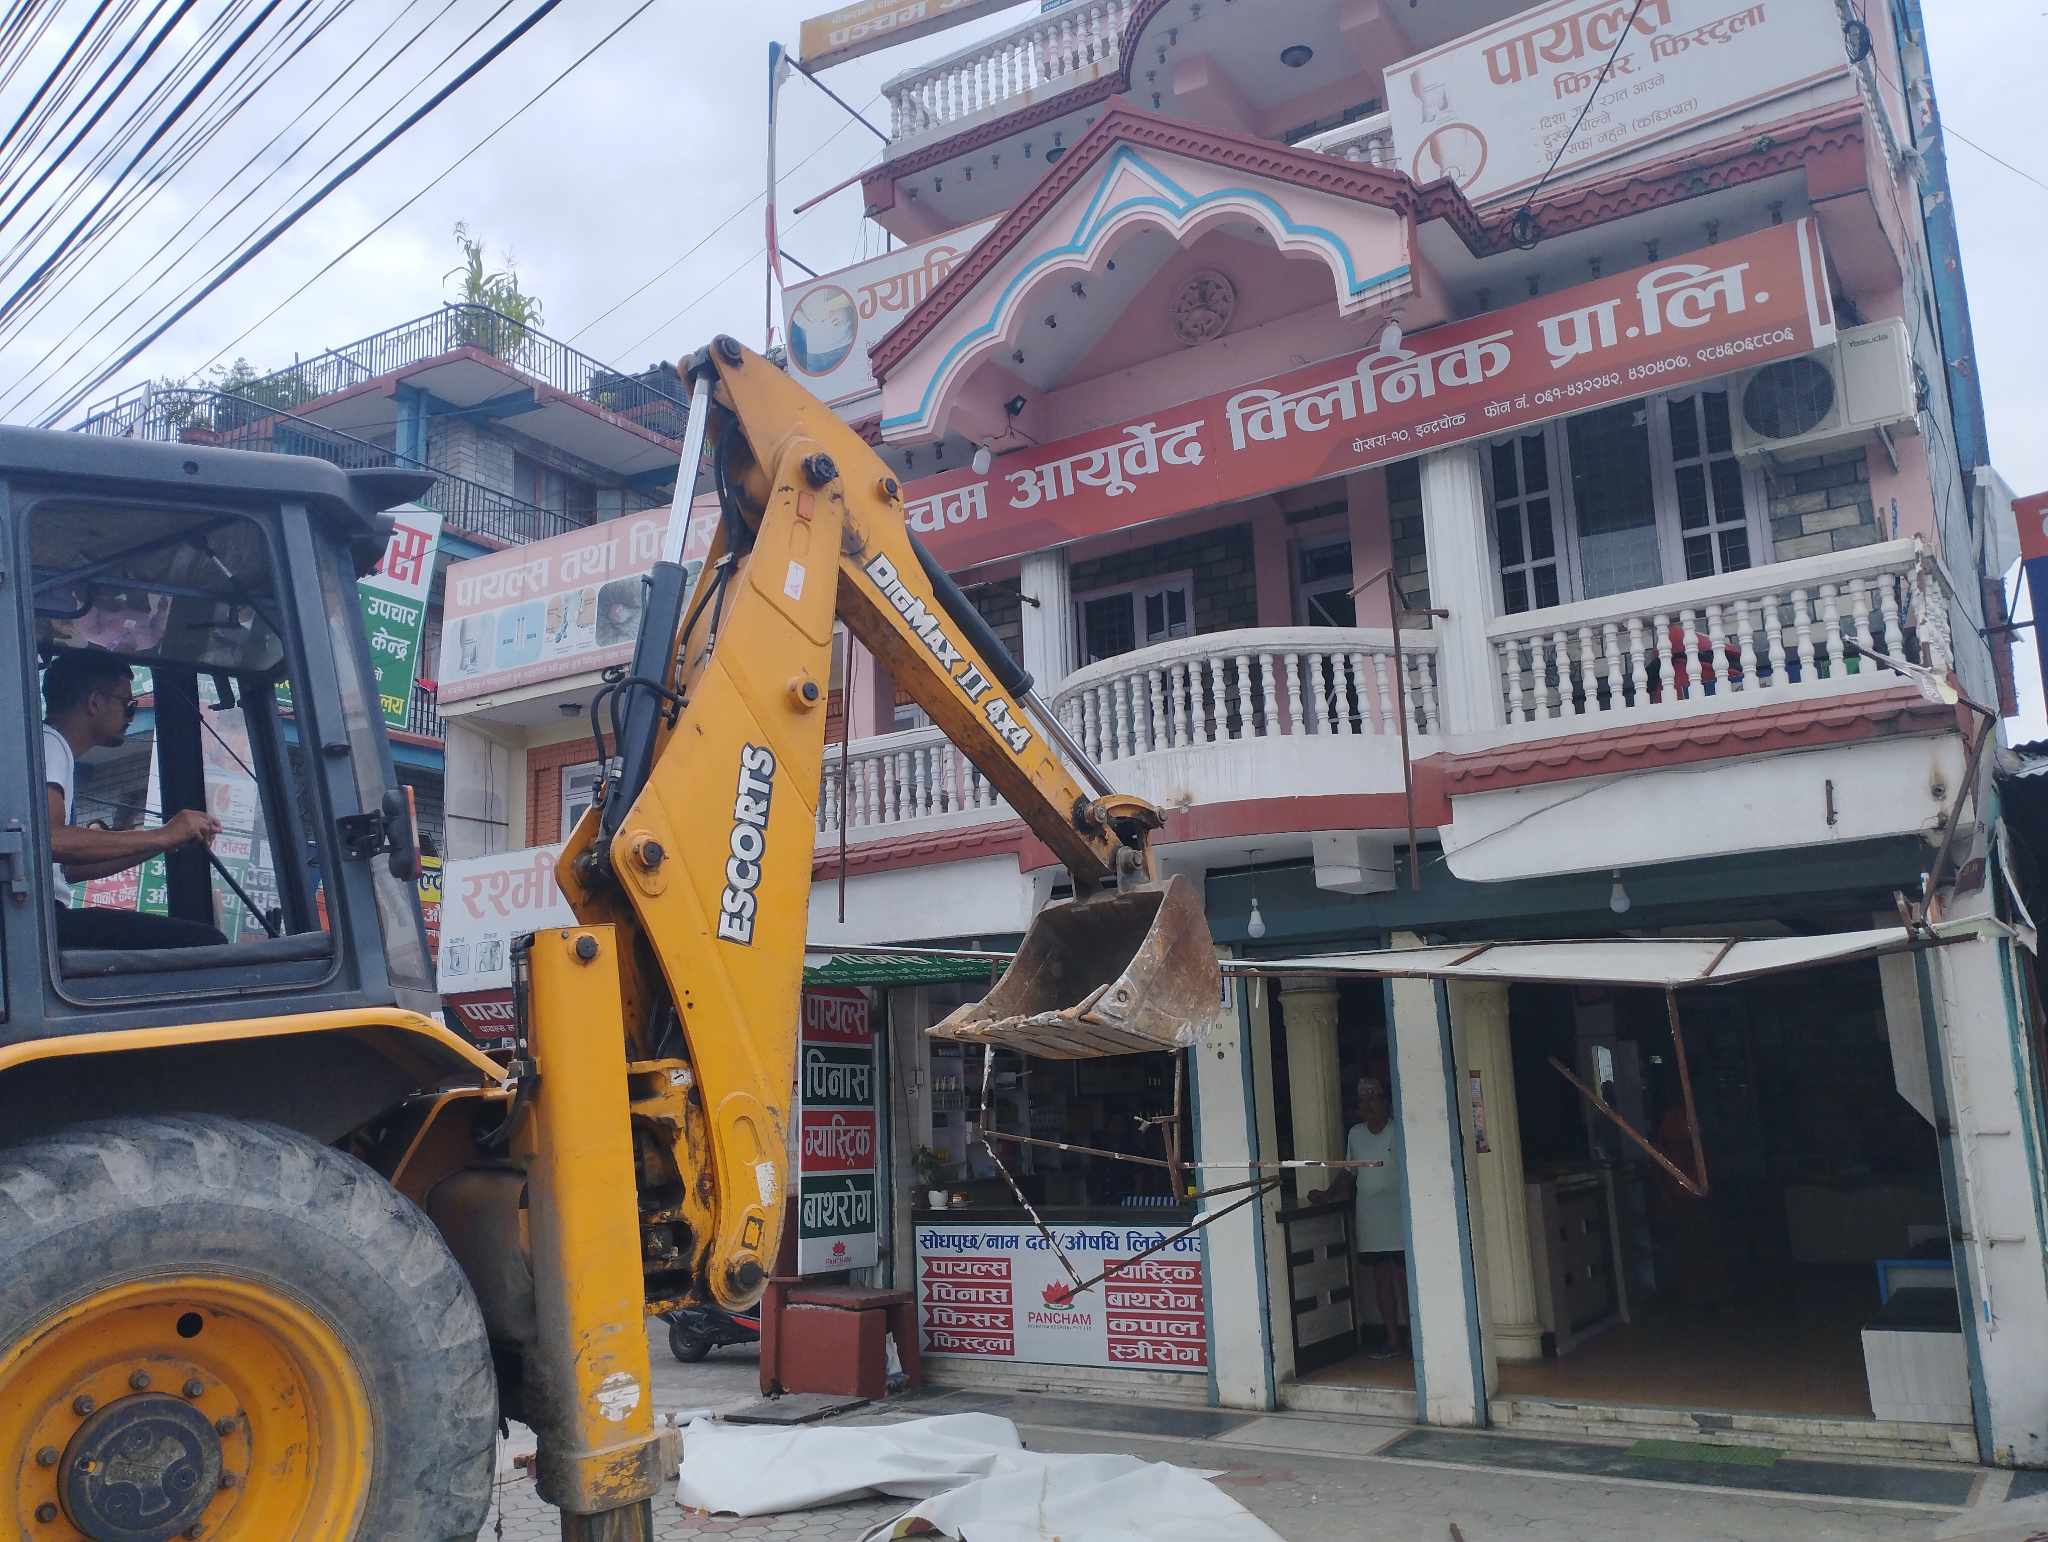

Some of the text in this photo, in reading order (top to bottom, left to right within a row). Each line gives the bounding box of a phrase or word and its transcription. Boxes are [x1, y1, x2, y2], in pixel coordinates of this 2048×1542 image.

[1650, 3, 1766, 63] फिस्टुला
[1005, 420, 1205, 509] आयूर्वेद
[1226, 329, 1514, 451] क्लिनिक
[1484, 400, 1511, 418] फोन
[455, 555, 552, 608] पायल्स
[560, 531, 627, 584] तथा
[368, 596, 418, 626] उपचार
[717, 742, 776, 946] ESCORTS
[806, 993, 870, 1036] पायल्स
[805, 1049, 871, 1101] पिनास
[805, 1114, 871, 1166] ग्यास्ट्रिक
[803, 1180, 872, 1229] बाथरोग
[930, 1261, 1009, 1277] पायल्स
[931, 1282, 1009, 1304] पिनास
[1107, 1288, 1197, 1310] बाथरोग
[932, 1306, 1010, 1328] फिसर
[1028, 1311, 1092, 1326] PANCHAM
[1108, 1317, 1199, 1336] कपाल
[933, 1331, 1012, 1353] फिस्टुला
